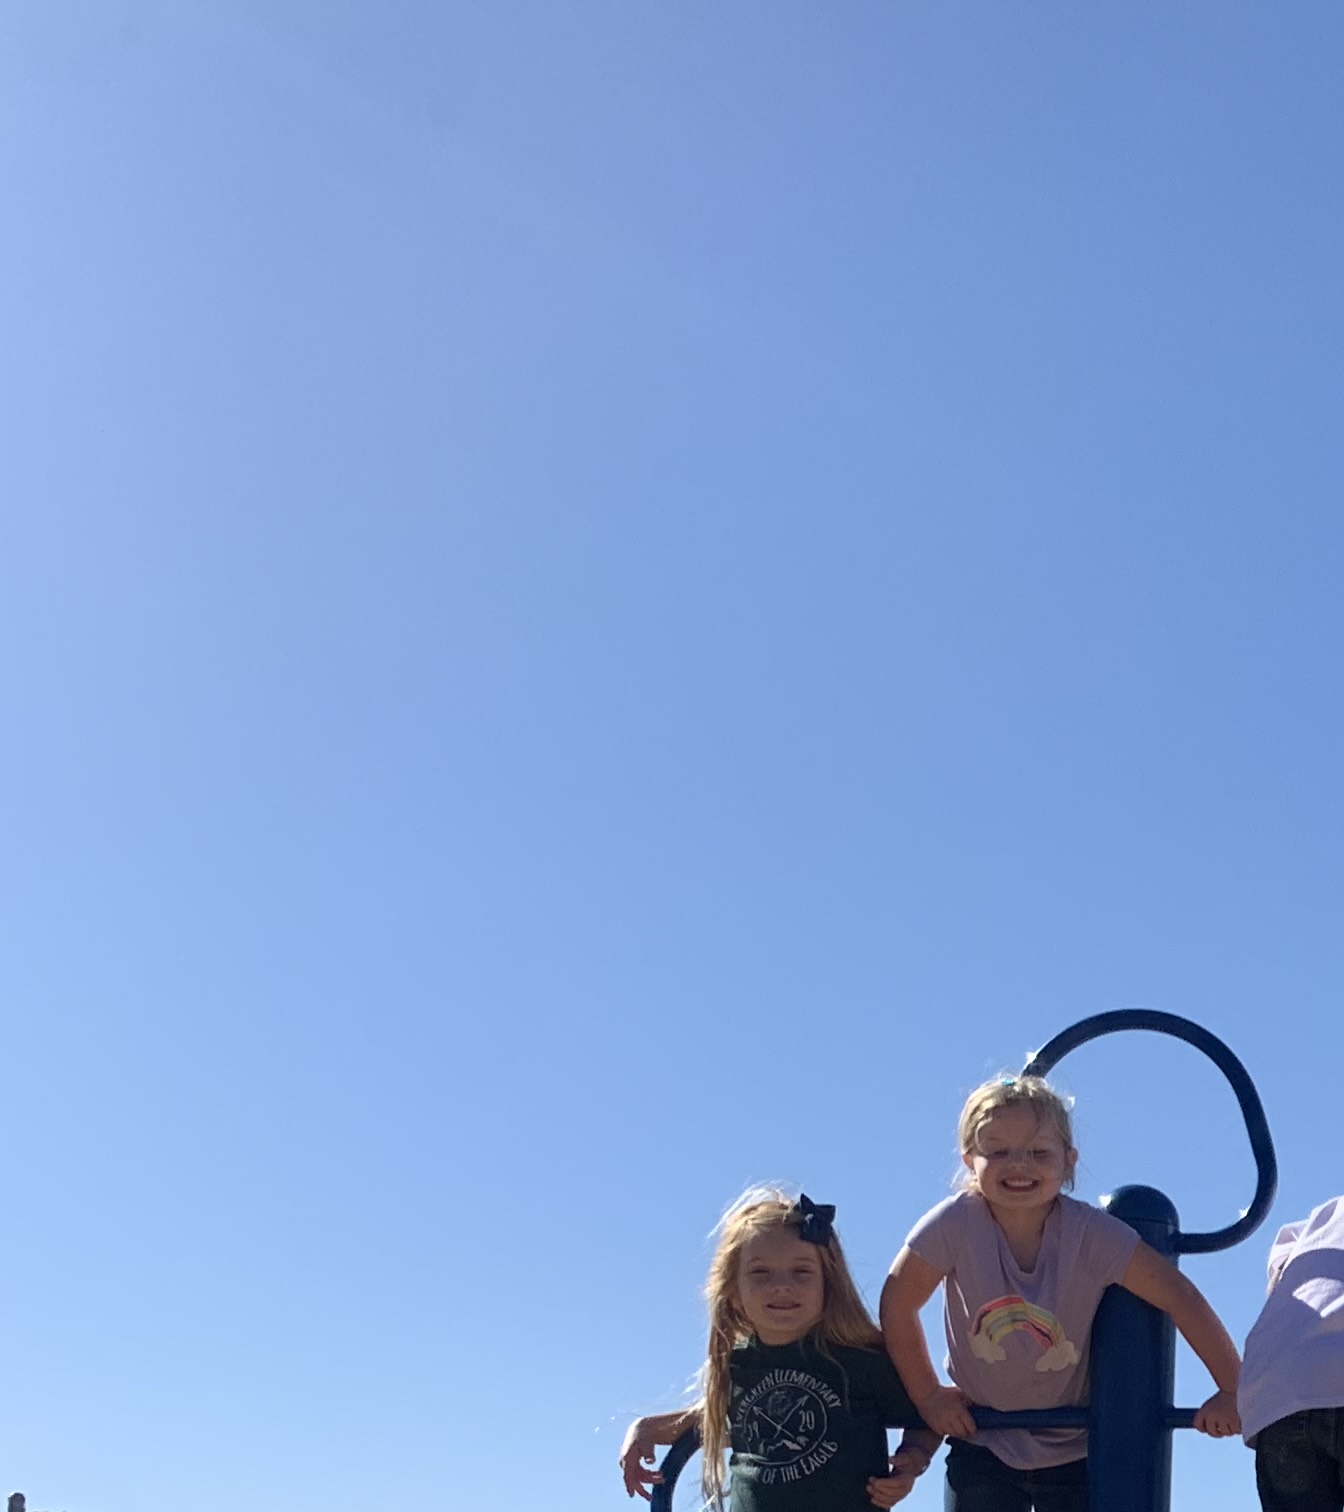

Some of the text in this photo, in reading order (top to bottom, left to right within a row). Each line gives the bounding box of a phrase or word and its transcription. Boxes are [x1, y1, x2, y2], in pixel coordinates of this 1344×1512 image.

[733, 1369, 842, 1428] EVERGREEN ELEMENTARY
[799, 1410, 815, 1433] 20
[762, 1468, 778, 1484] OF
[781, 1465, 801, 1483] THE
